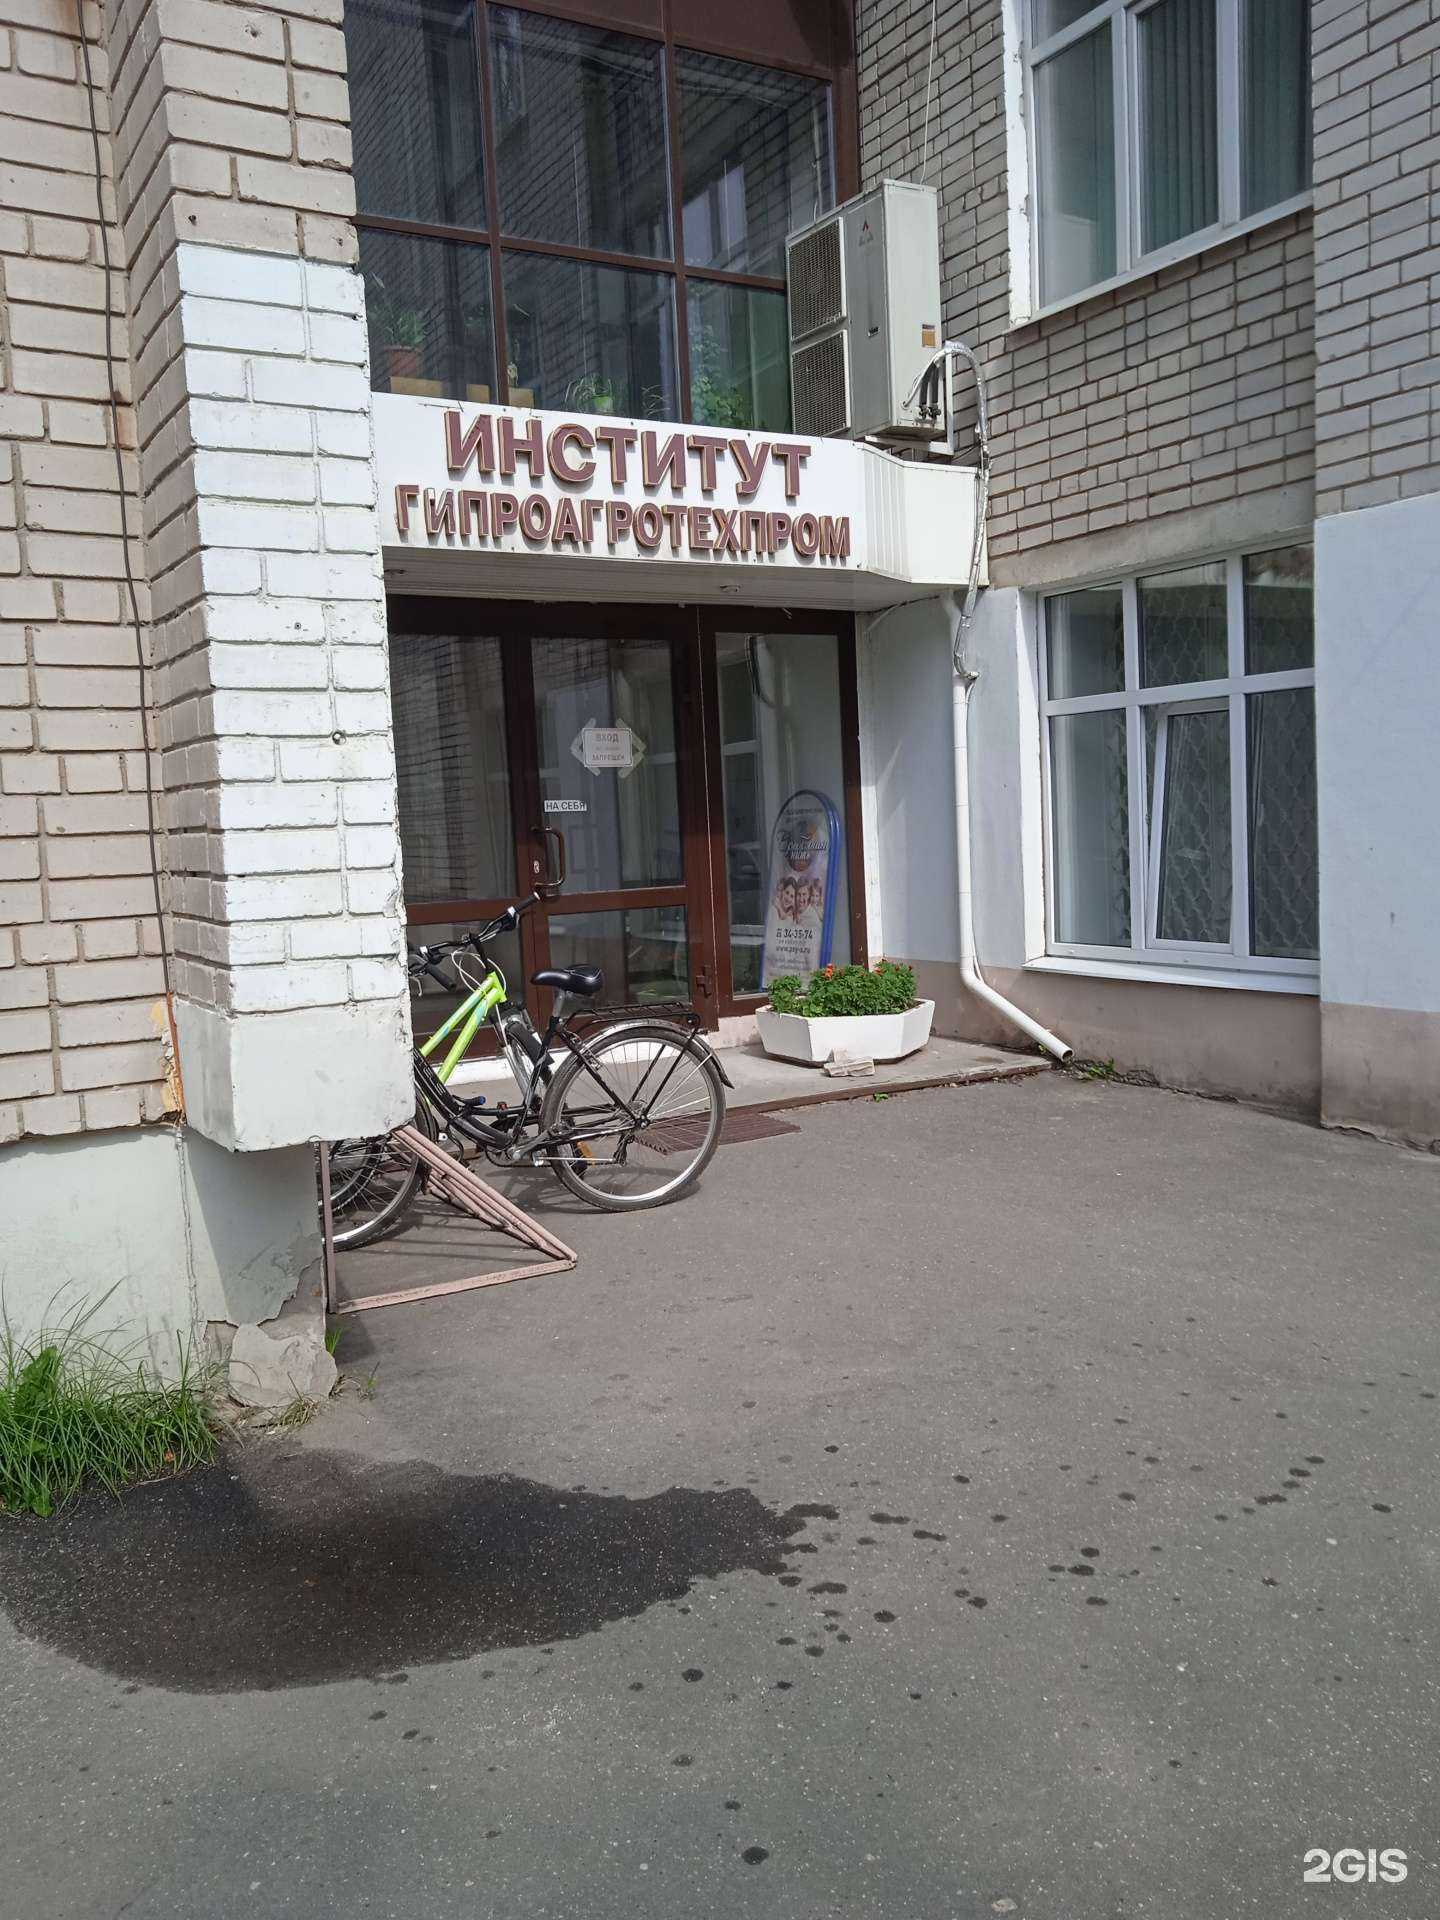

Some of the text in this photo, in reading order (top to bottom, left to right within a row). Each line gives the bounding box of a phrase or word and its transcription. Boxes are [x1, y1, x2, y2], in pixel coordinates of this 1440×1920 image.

[443, 410, 812, 498] ИНСТИТУТ
[394, 484, 851, 558] ГИПРОАГРОТЕХПРОМ
[595, 732, 619, 744] ВХОД
[545, 801, 586, 811] НА СЕБЯ
